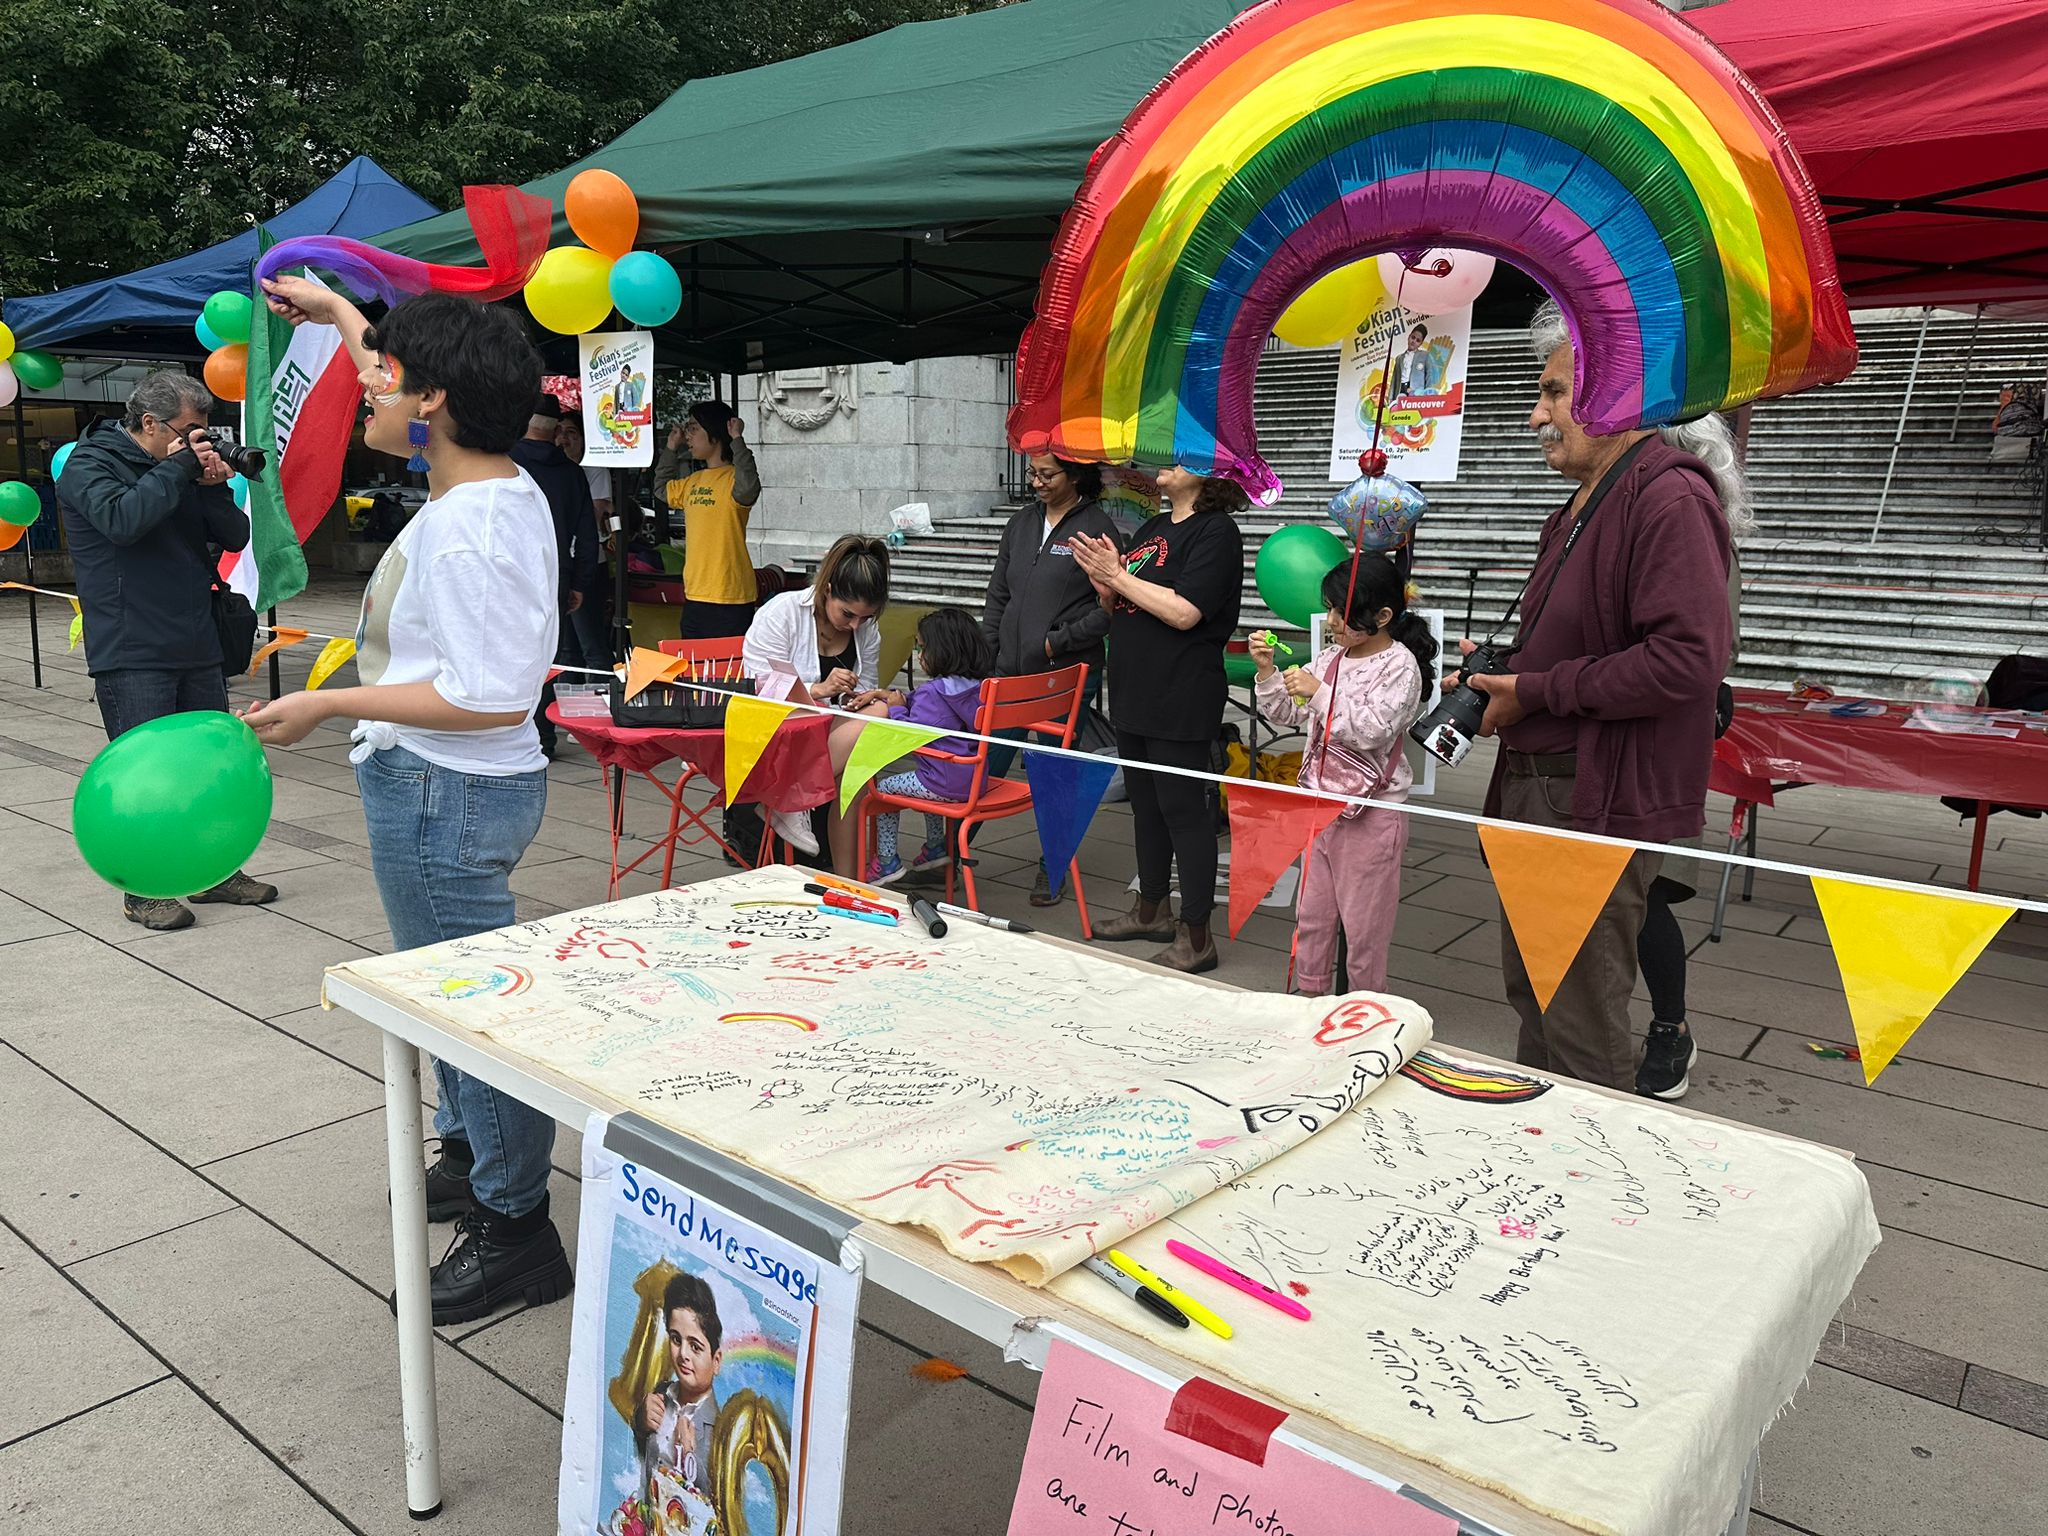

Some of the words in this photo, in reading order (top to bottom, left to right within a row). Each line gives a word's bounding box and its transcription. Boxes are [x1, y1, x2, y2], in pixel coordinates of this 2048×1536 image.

[1370, 304, 1411, 328] Kian's
[1406, 313, 1435, 326] Worldw
[1354, 318, 1406, 352] Festival
[598, 349, 621, 367] Kian's
[589, 360, 620, 382] Festival
[1401, 399, 1446, 410] Vancouver
[1566, 519, 1582, 549] SONY
[639, 1086, 664, 1095] and
[707, 1079, 752, 1092] family
[622, 1163, 695, 1237] Send
[700, 1217, 816, 1305] Message
[1479, 1281, 1530, 1306] Happy
[1508, 1247, 1560, 1278] Birthday
[1063, 1397, 1130, 1467] Film
[1153, 1468, 1199, 1497] and
[1212, 1494, 1294, 1536] photo
